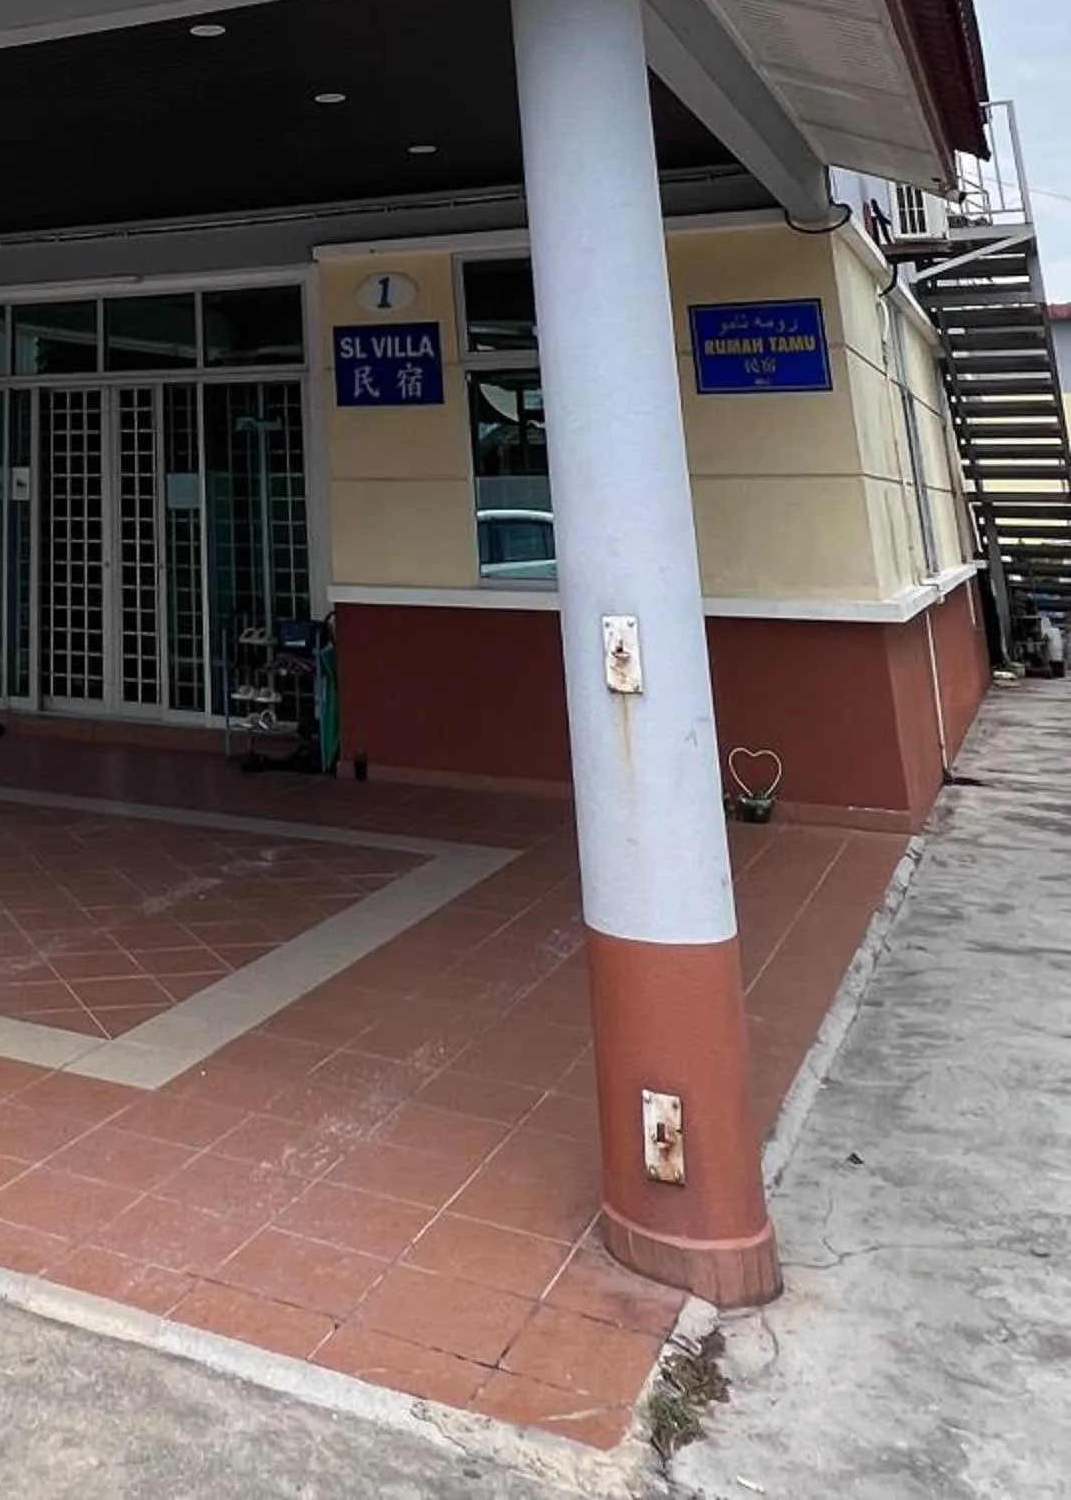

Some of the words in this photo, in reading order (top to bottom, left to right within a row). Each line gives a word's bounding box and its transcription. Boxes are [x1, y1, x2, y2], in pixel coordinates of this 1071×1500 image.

[377, 276, 392, 308] 1
[340, 337, 367, 359] SL
[371, 335, 435, 358] VILLA
[704, 338, 764, 356] RUMAH
[768, 334, 816, 352] TAMU
[353, 363, 423, 399] 民宿
